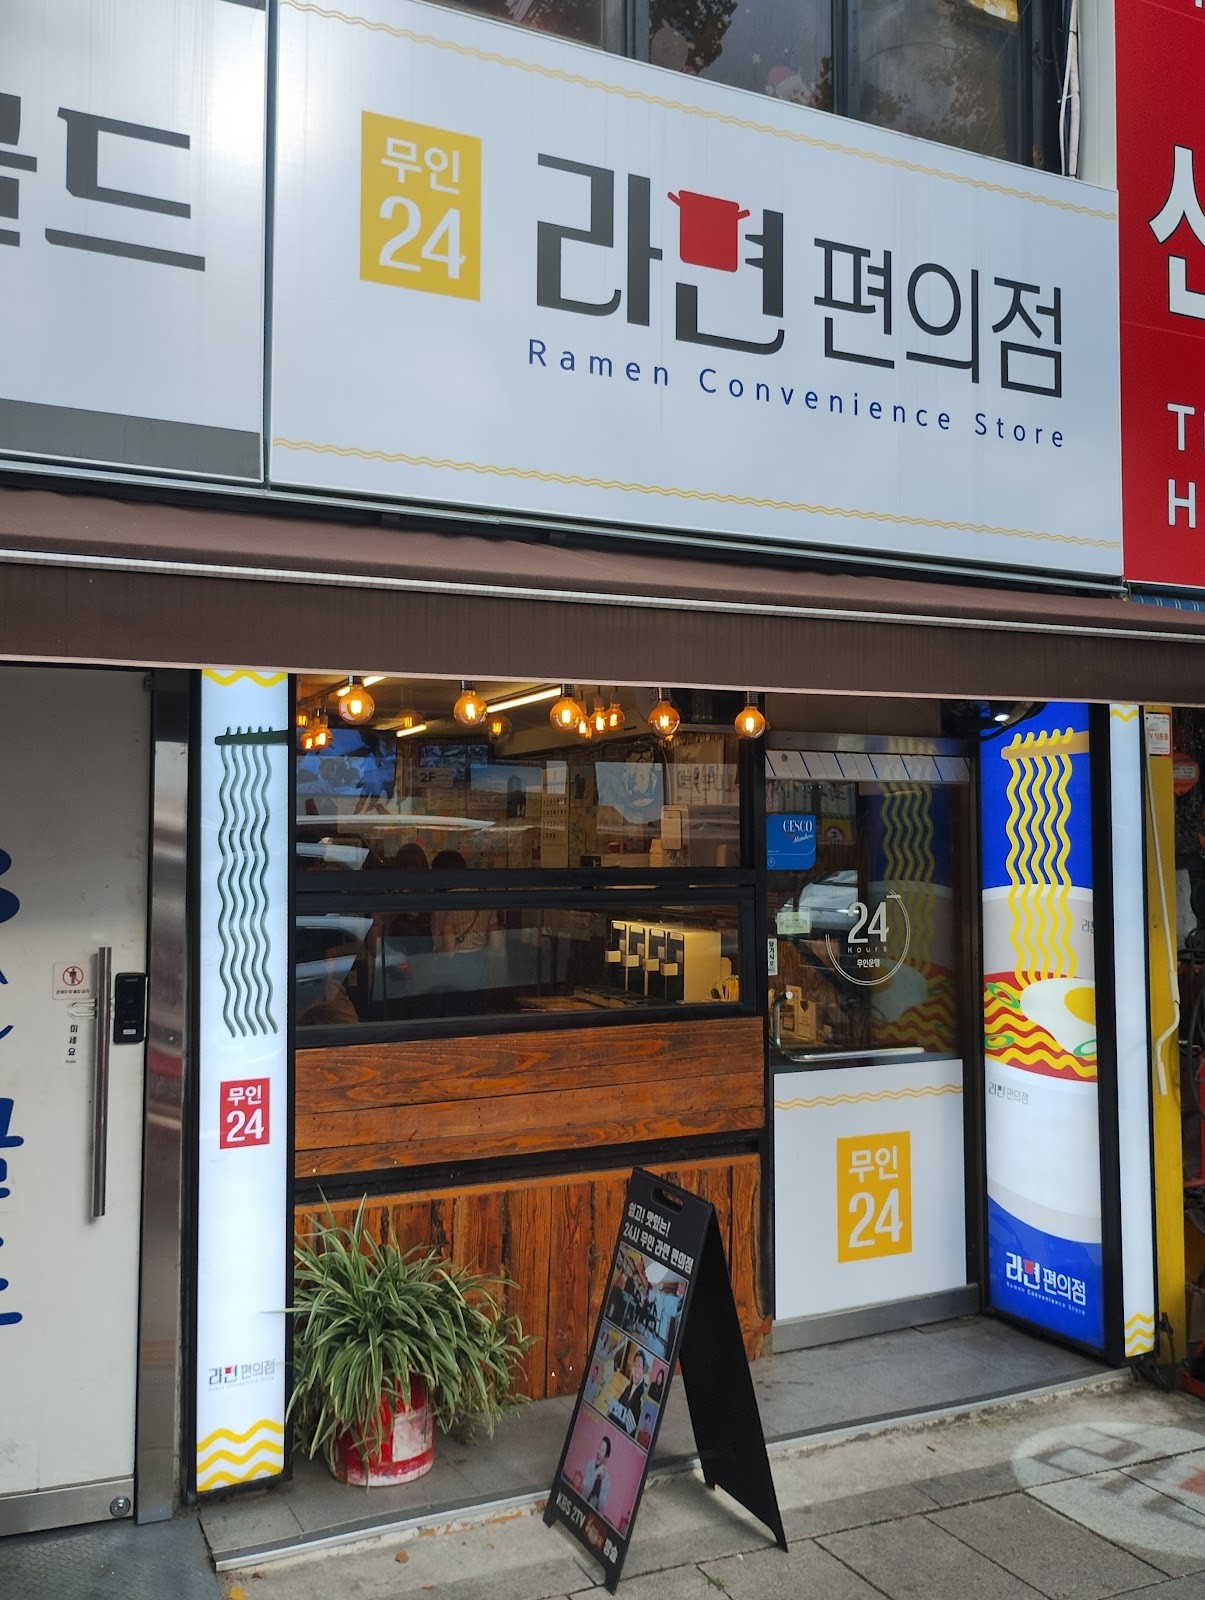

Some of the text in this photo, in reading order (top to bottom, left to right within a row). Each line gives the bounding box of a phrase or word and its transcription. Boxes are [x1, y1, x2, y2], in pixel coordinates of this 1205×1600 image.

[380, 136, 461, 195] 무인
[378, 196, 466, 280] 24
[537, 153, 1062, 399] 라면 편의점
[529, 338, 1063, 448] Ramen Convenience Store
[783, 819, 813, 832] CESCO
[847, 902, 890, 944] 24
[227, 1084, 262, 1107] 무인
[226, 1108, 265, 1143] 24
[848, 1145, 899, 1183] 무인
[627, 1201, 671, 1238] 쉽고! 맛있는!
[848, 1188, 903, 1249] 24
[622, 1222, 641, 1243] 24시
[640, 1230, 656, 1252] 무인
[670, 1247, 695, 1275] 편의점
[1006, 1251, 1086, 1306] 라면 편의점
[555, 1490, 573, 1516] KBS
